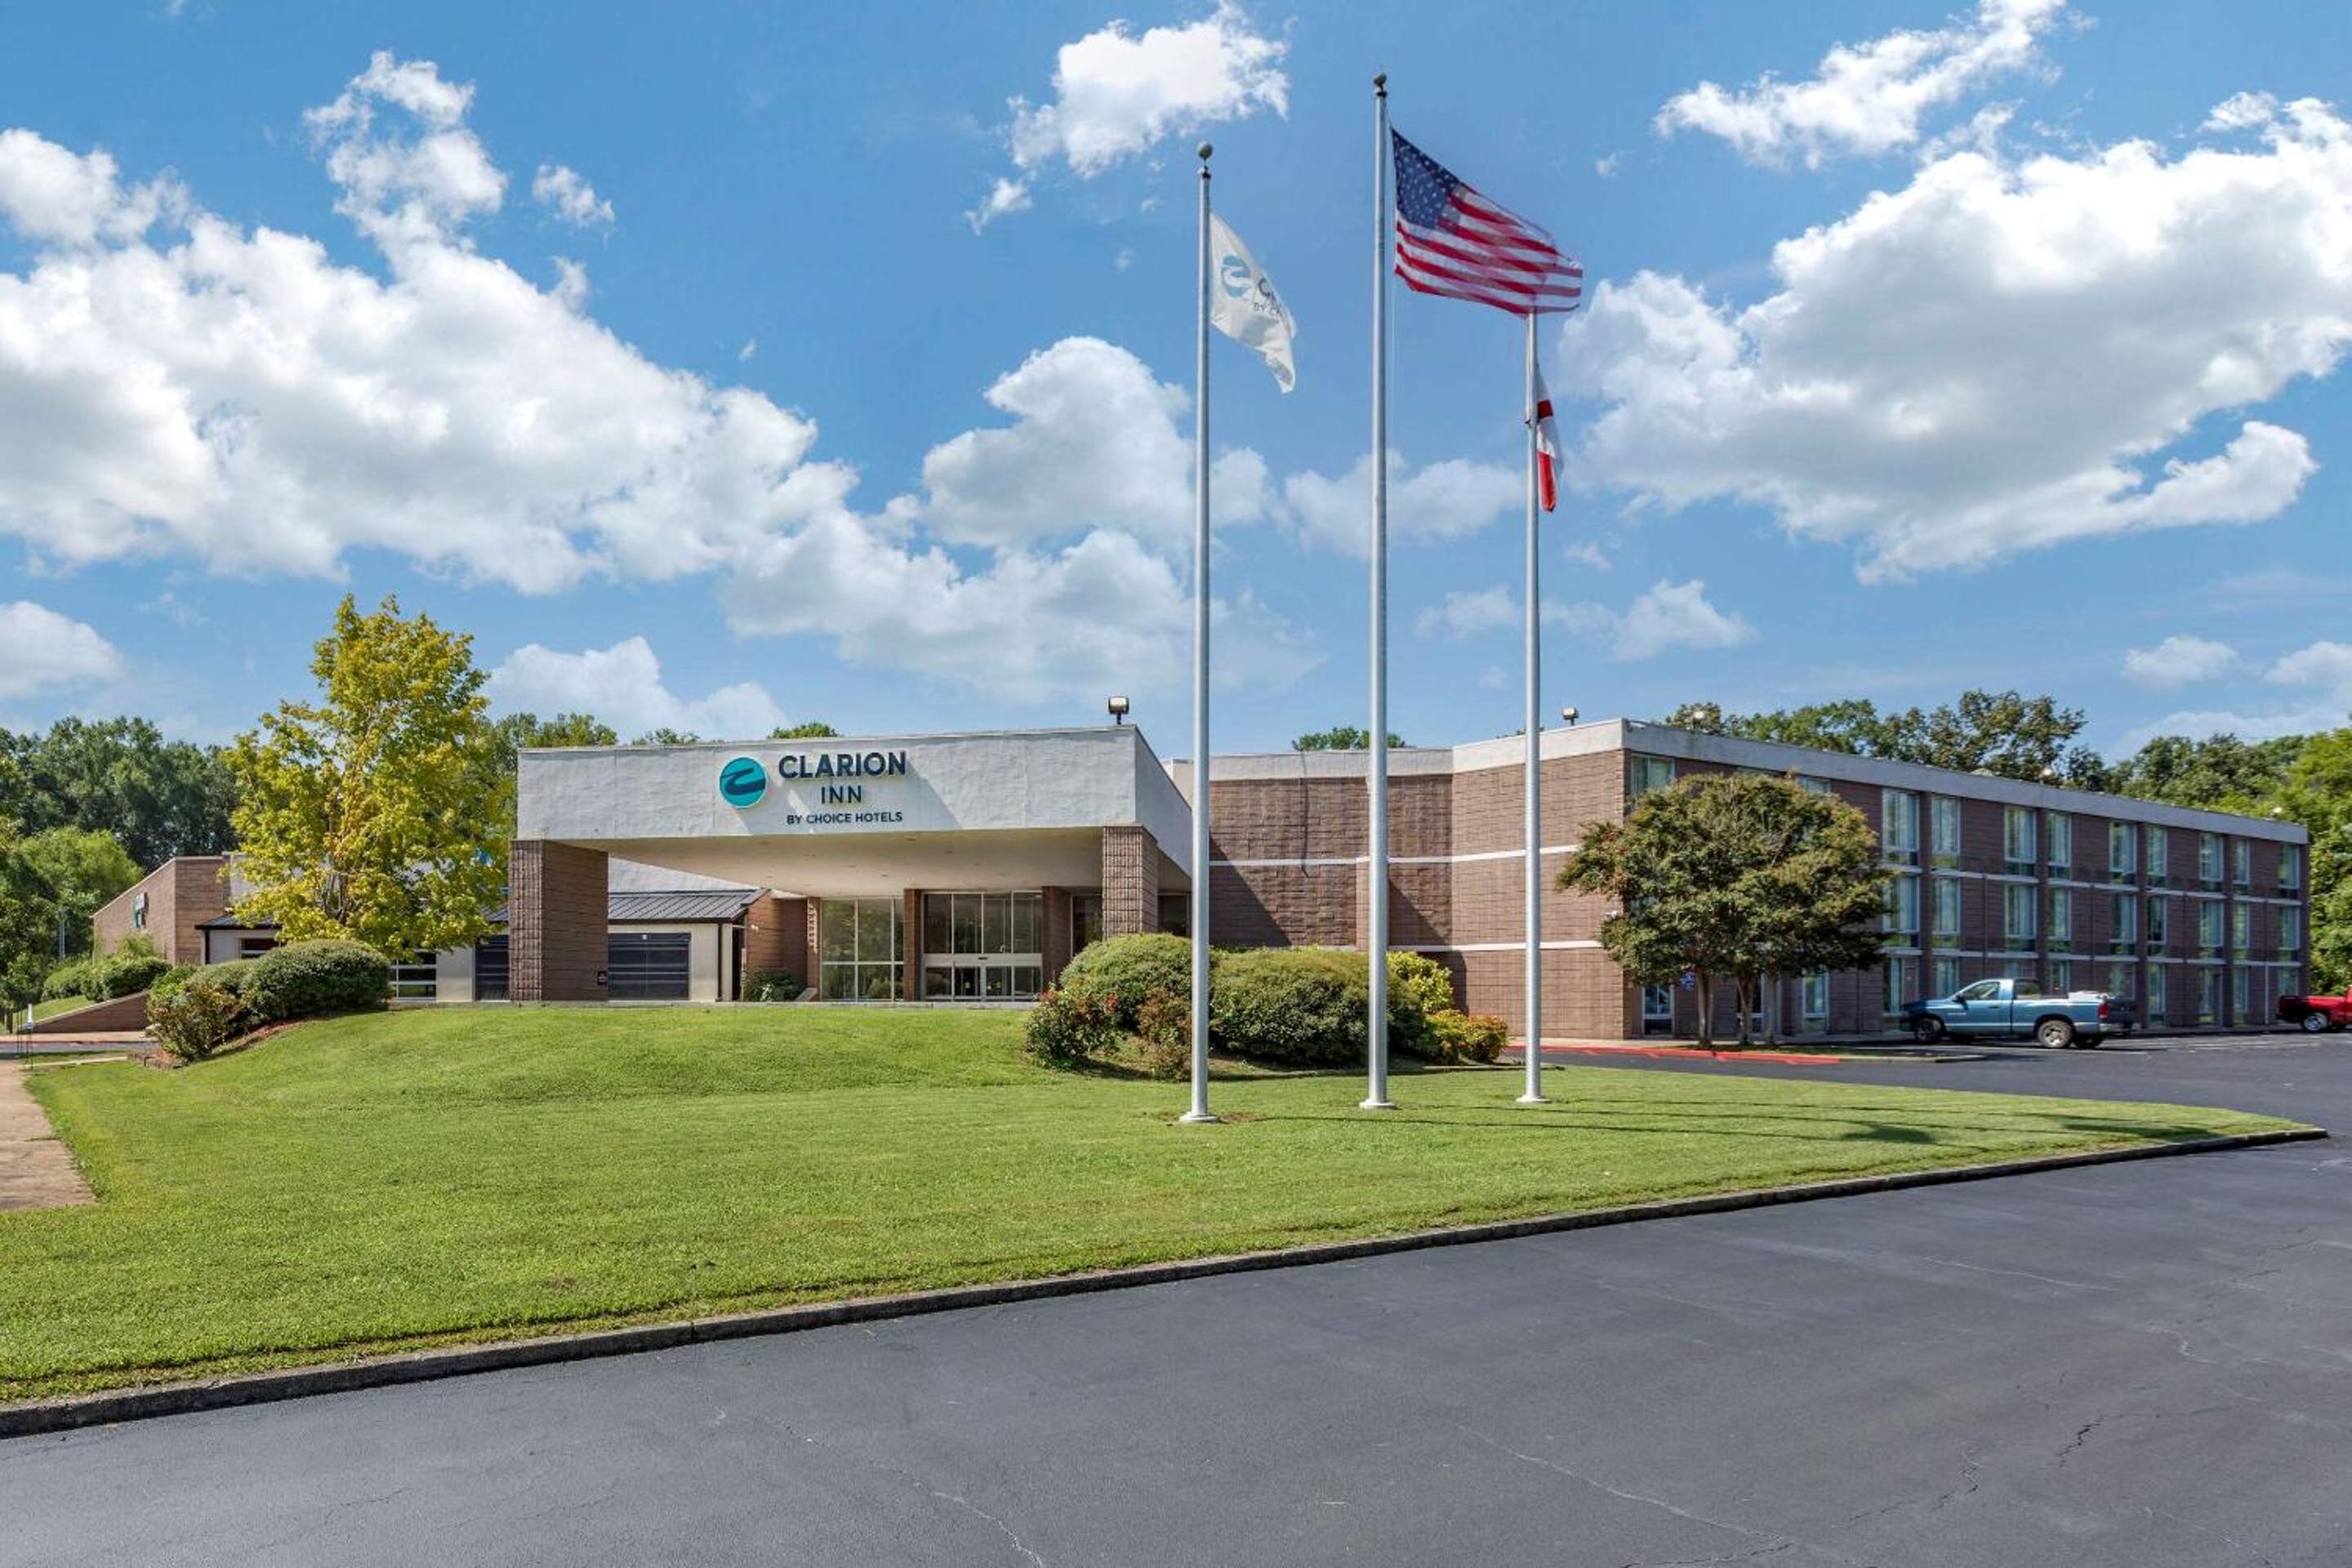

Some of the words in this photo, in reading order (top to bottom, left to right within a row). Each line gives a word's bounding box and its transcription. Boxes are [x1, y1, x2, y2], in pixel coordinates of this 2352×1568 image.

[778, 751, 906, 778] CLARION
[822, 785, 862, 804] INN
[786, 815, 803, 825] BY
[807, 813, 852, 824] CHOICE
[855, 812, 902, 822] HOTELS
